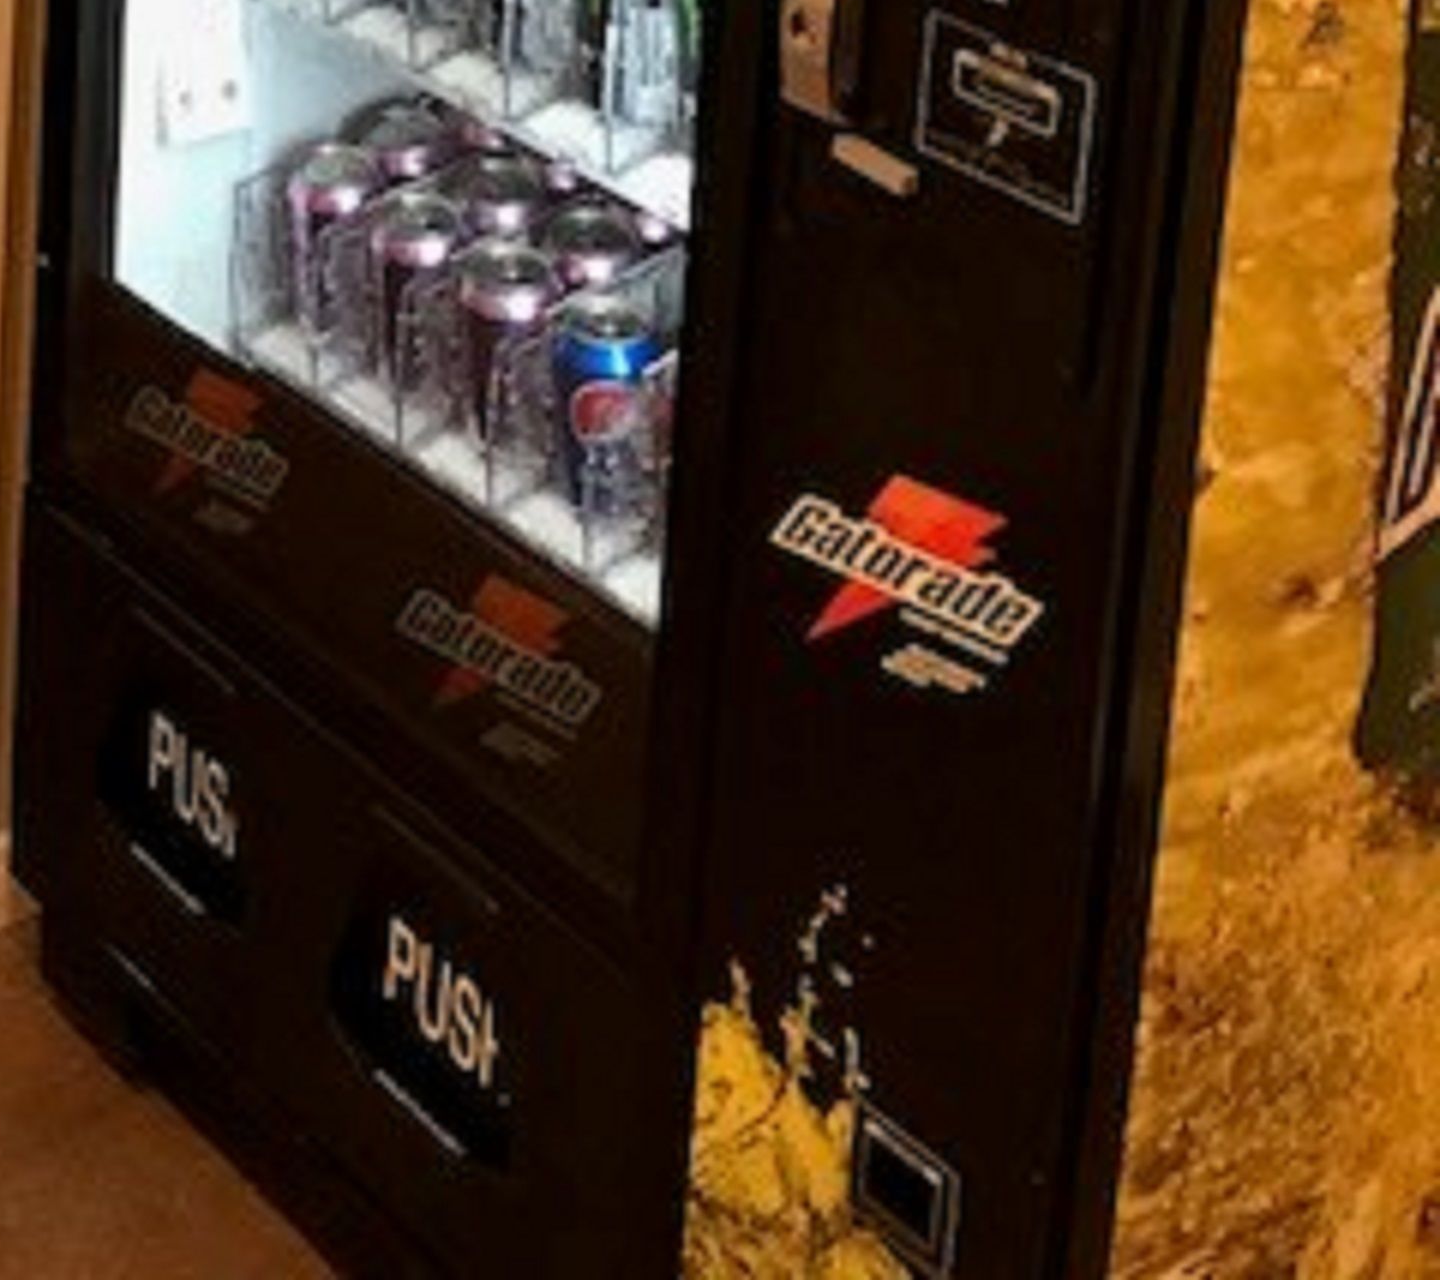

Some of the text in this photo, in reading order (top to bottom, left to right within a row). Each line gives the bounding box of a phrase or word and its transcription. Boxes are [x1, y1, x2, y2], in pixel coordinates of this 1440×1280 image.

[771, 496, 1042, 646] Gatorade
[396, 589, 600, 724] Gatorade
[149, 710, 237, 860] PUS
